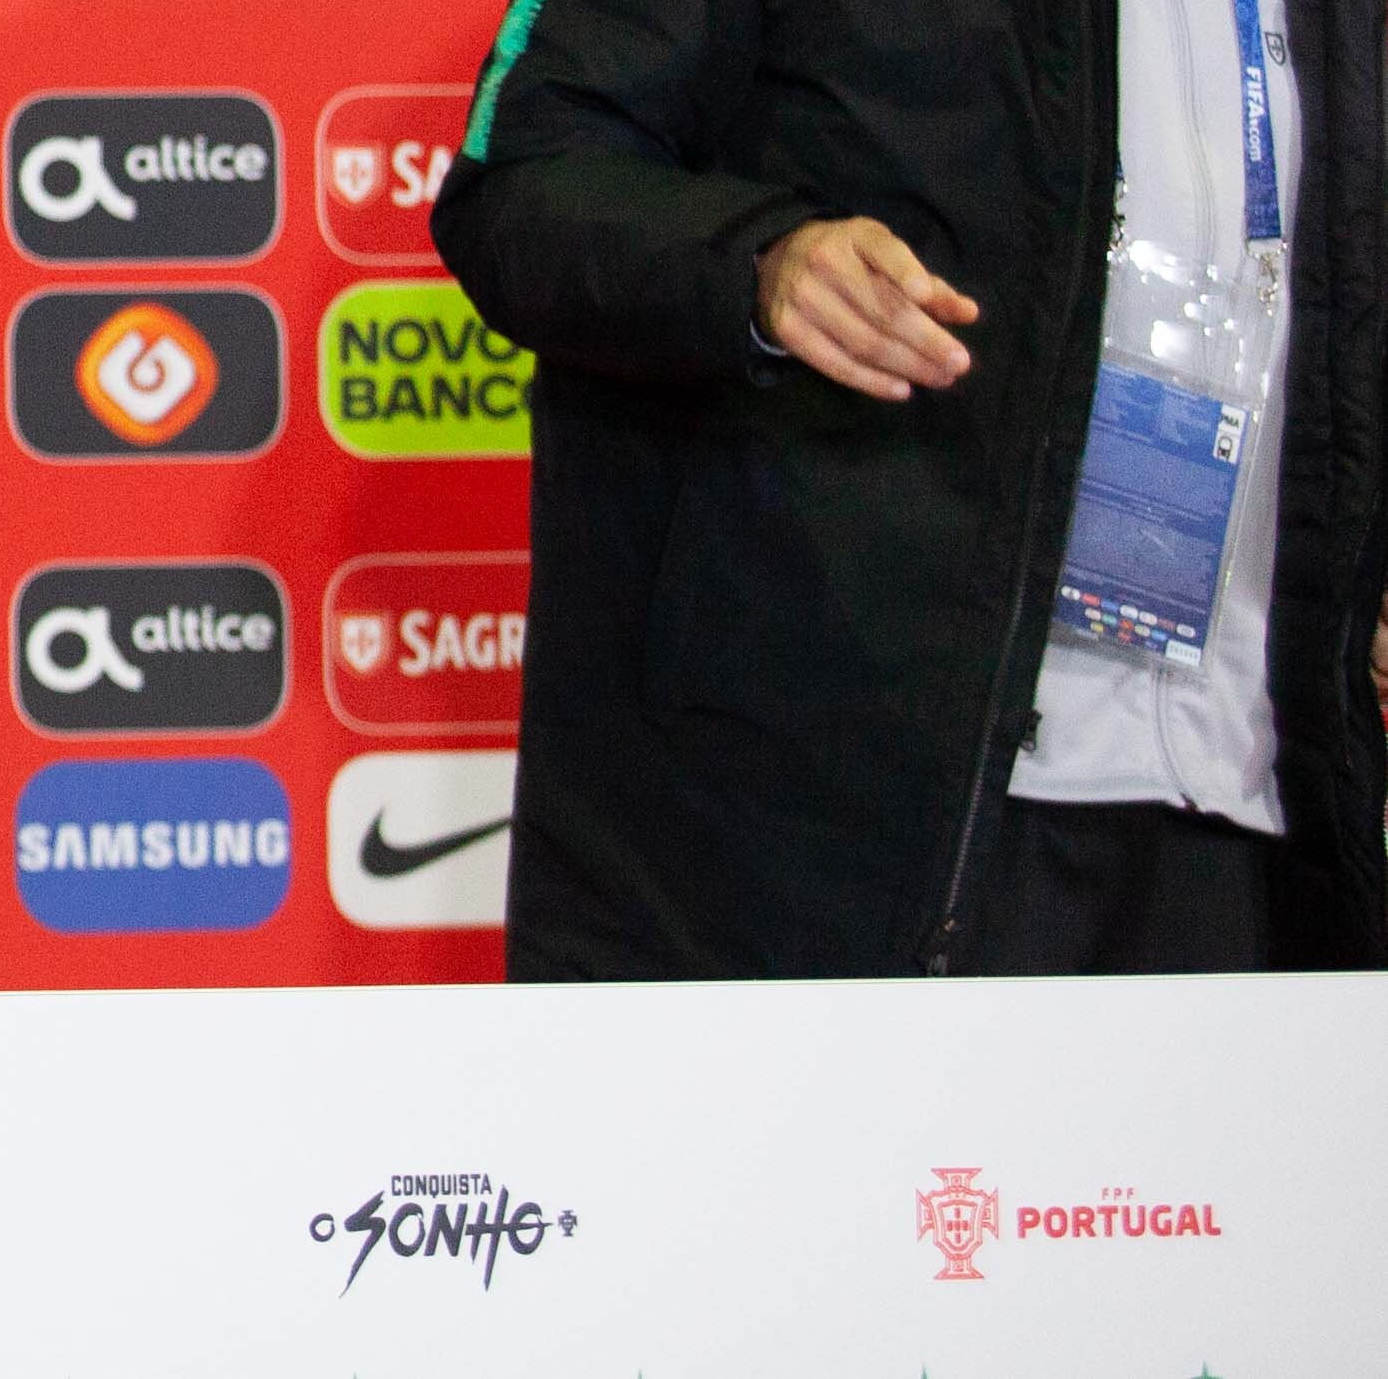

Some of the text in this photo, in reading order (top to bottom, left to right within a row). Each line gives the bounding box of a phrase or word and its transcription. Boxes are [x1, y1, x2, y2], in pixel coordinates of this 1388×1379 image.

[125, 135, 267, 181] altice
[340, 318, 520, 364] NOVO
[340, 375, 535, 420] BANC
[131, 606, 274, 652] altice
[397, 607, 527, 679] SAGR
[17, 819, 289, 872] SAMSUNG
[390, 1173, 492, 1198] CONQUISTA
[1101, 1187, 1135, 1200] FPF
[309, 1213, 336, 1243] O
[1016, 1203, 1222, 1239] PORTUGAL
